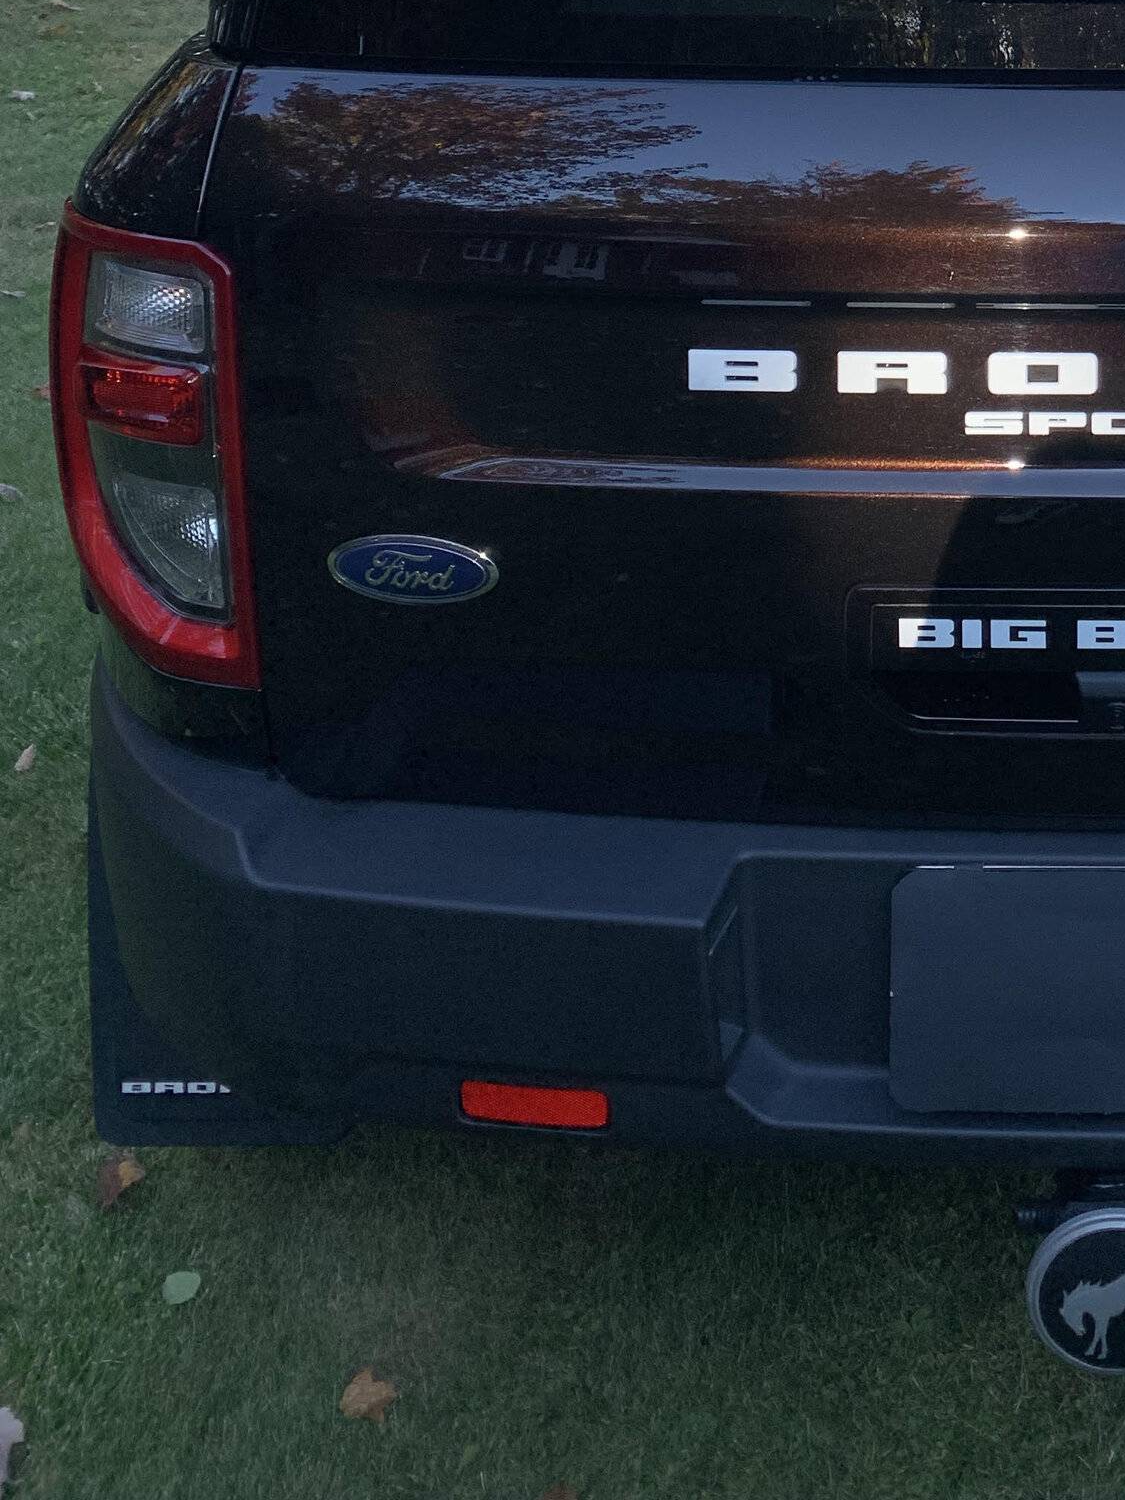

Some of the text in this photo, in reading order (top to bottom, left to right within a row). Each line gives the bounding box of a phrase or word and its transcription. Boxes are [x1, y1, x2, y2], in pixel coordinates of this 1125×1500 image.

[364, 549, 456, 590] Ford
[898, 617, 1047, 650] BIG
[121, 1081, 231, 1094] BRO
